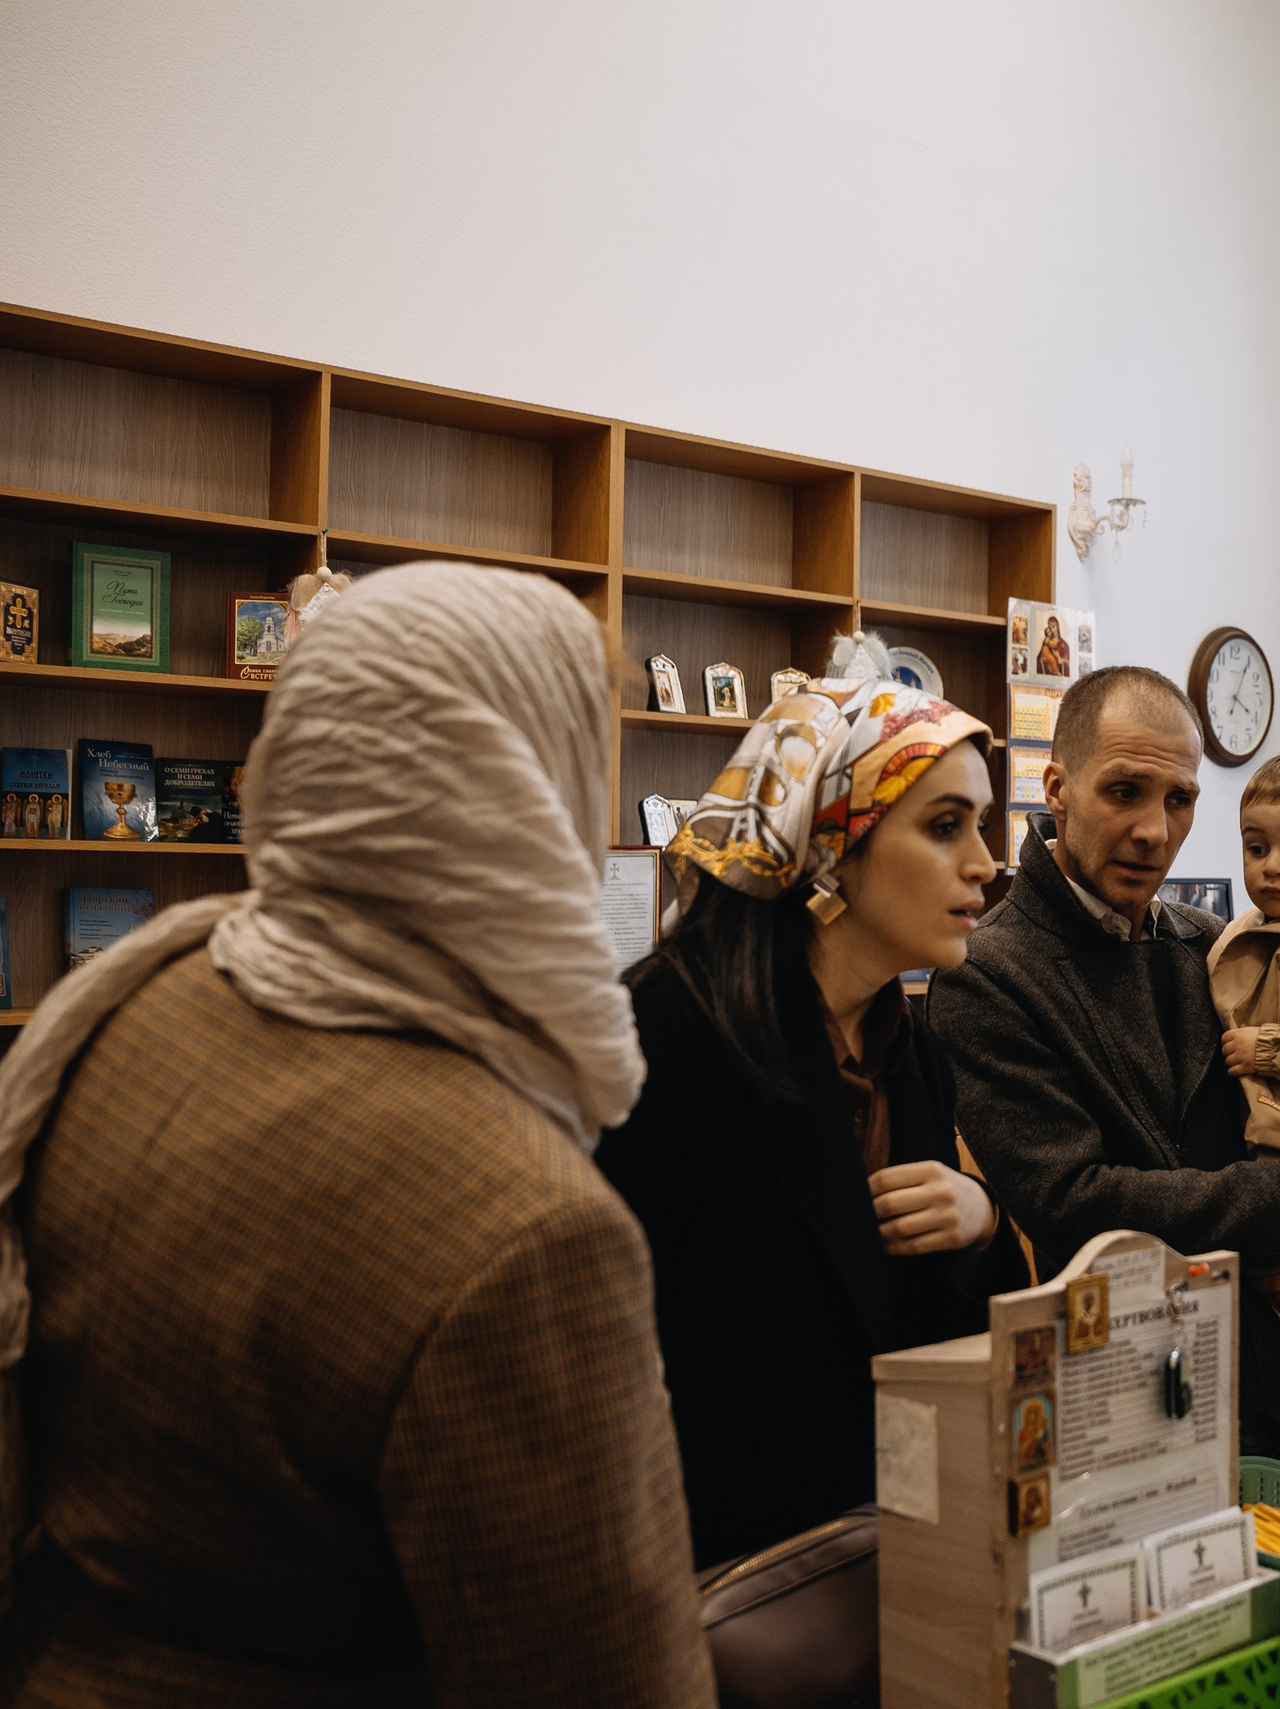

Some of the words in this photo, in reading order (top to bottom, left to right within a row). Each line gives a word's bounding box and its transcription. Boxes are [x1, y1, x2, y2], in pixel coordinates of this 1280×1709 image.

[1230, 645, 1240, 660] 12
[1252, 672, 1260, 688] 2
[1256, 691, 1262, 707] 3
[1250, 711, 1258, 725] 4
[1217, 725, 1224, 740] 7
[1245, 728, 1252, 744] 5
[1229, 734, 1238, 751] 6
[87, 748, 111, 759] Хлеб
[99, 759, 149, 771] Небесный
[164, 779, 216, 787] ДОБРОДЕТЕЛЯХ
